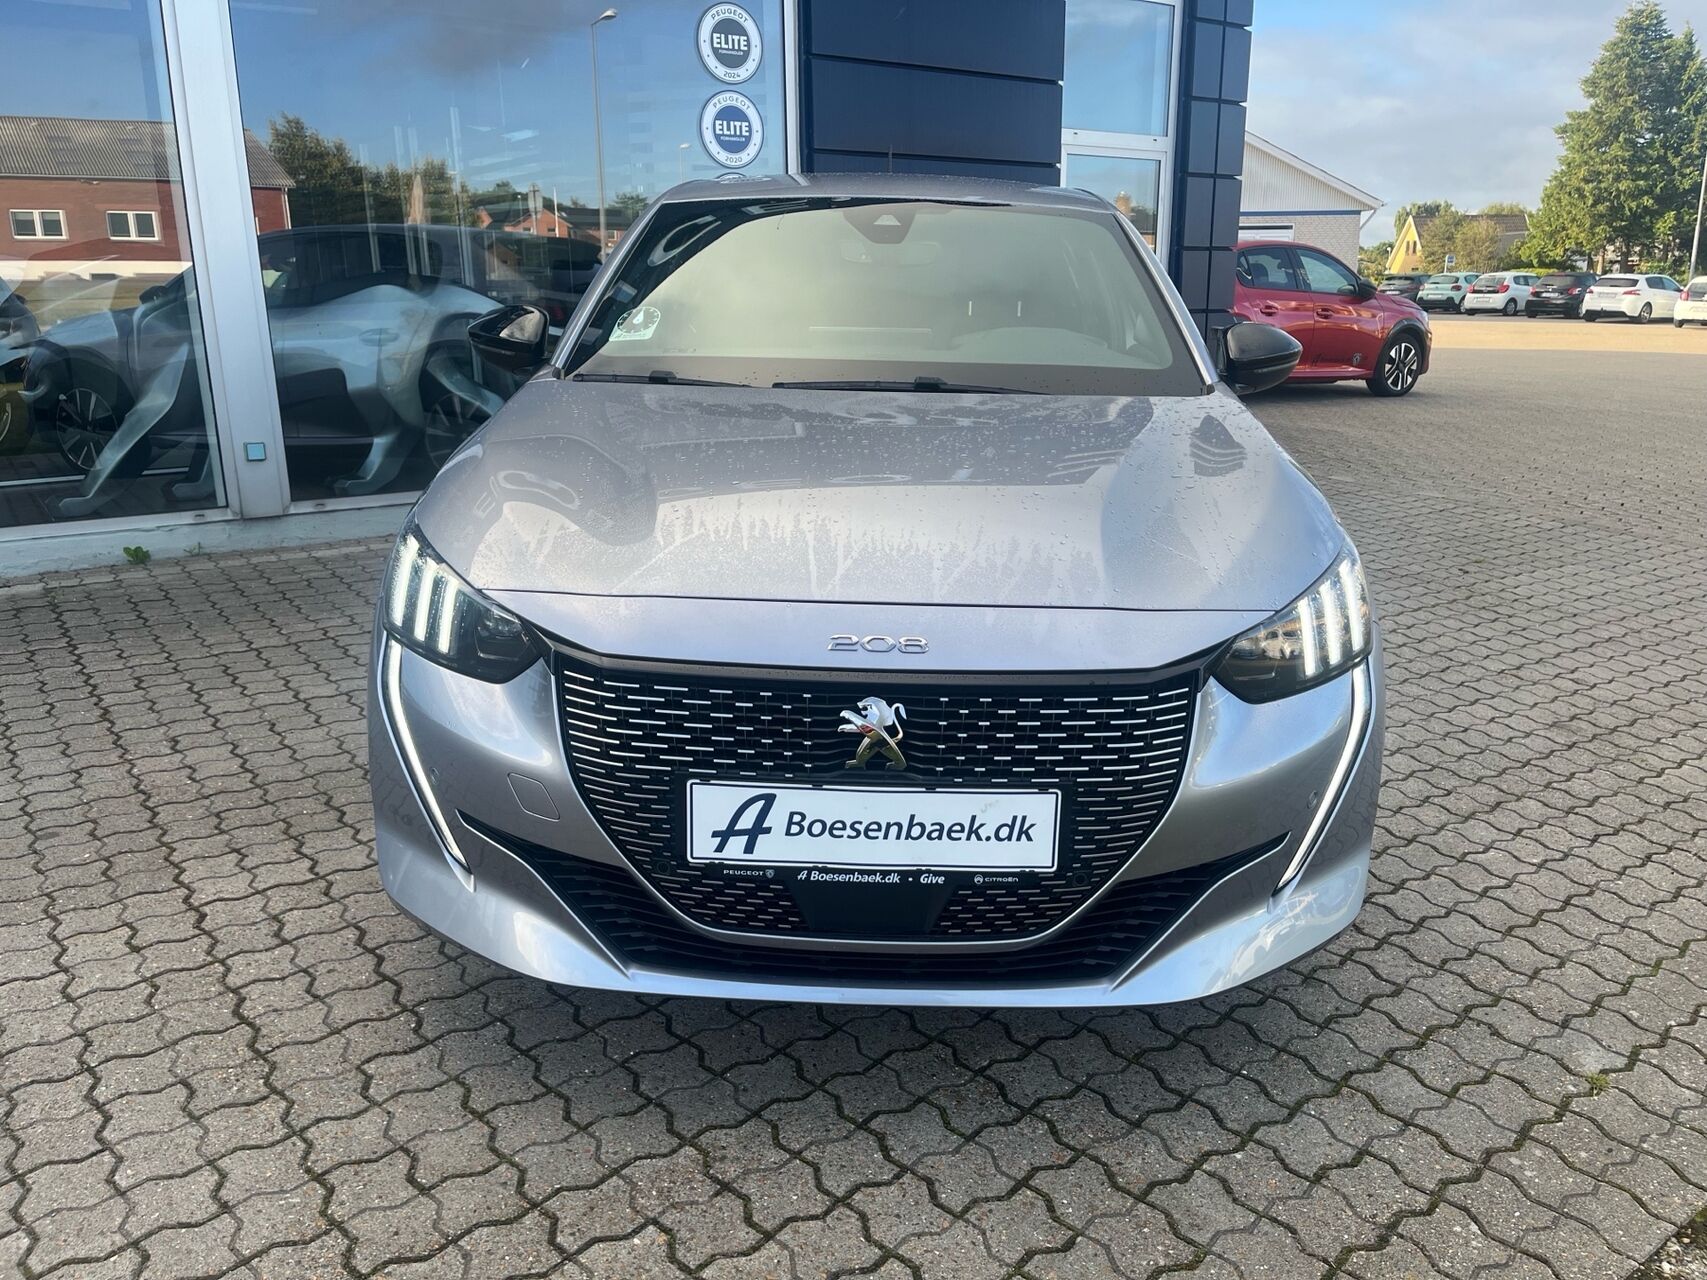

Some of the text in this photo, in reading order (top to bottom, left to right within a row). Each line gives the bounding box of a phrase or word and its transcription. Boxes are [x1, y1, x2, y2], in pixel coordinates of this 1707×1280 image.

[711, 8, 749, 23] PEUGEOT
[713, 33, 748, 50] ELITE
[724, 71, 740, 79] 2024
[713, 96, 750, 110] PEUGEOT
[715, 120, 749, 135] ELITE
[827, 633, 929, 654] 208
[784, 811, 1037, 842] Boesenbaek.dk
[810, 870, 900, 883] Boesenbaek.dk
[920, 873, 945, 884] Give
